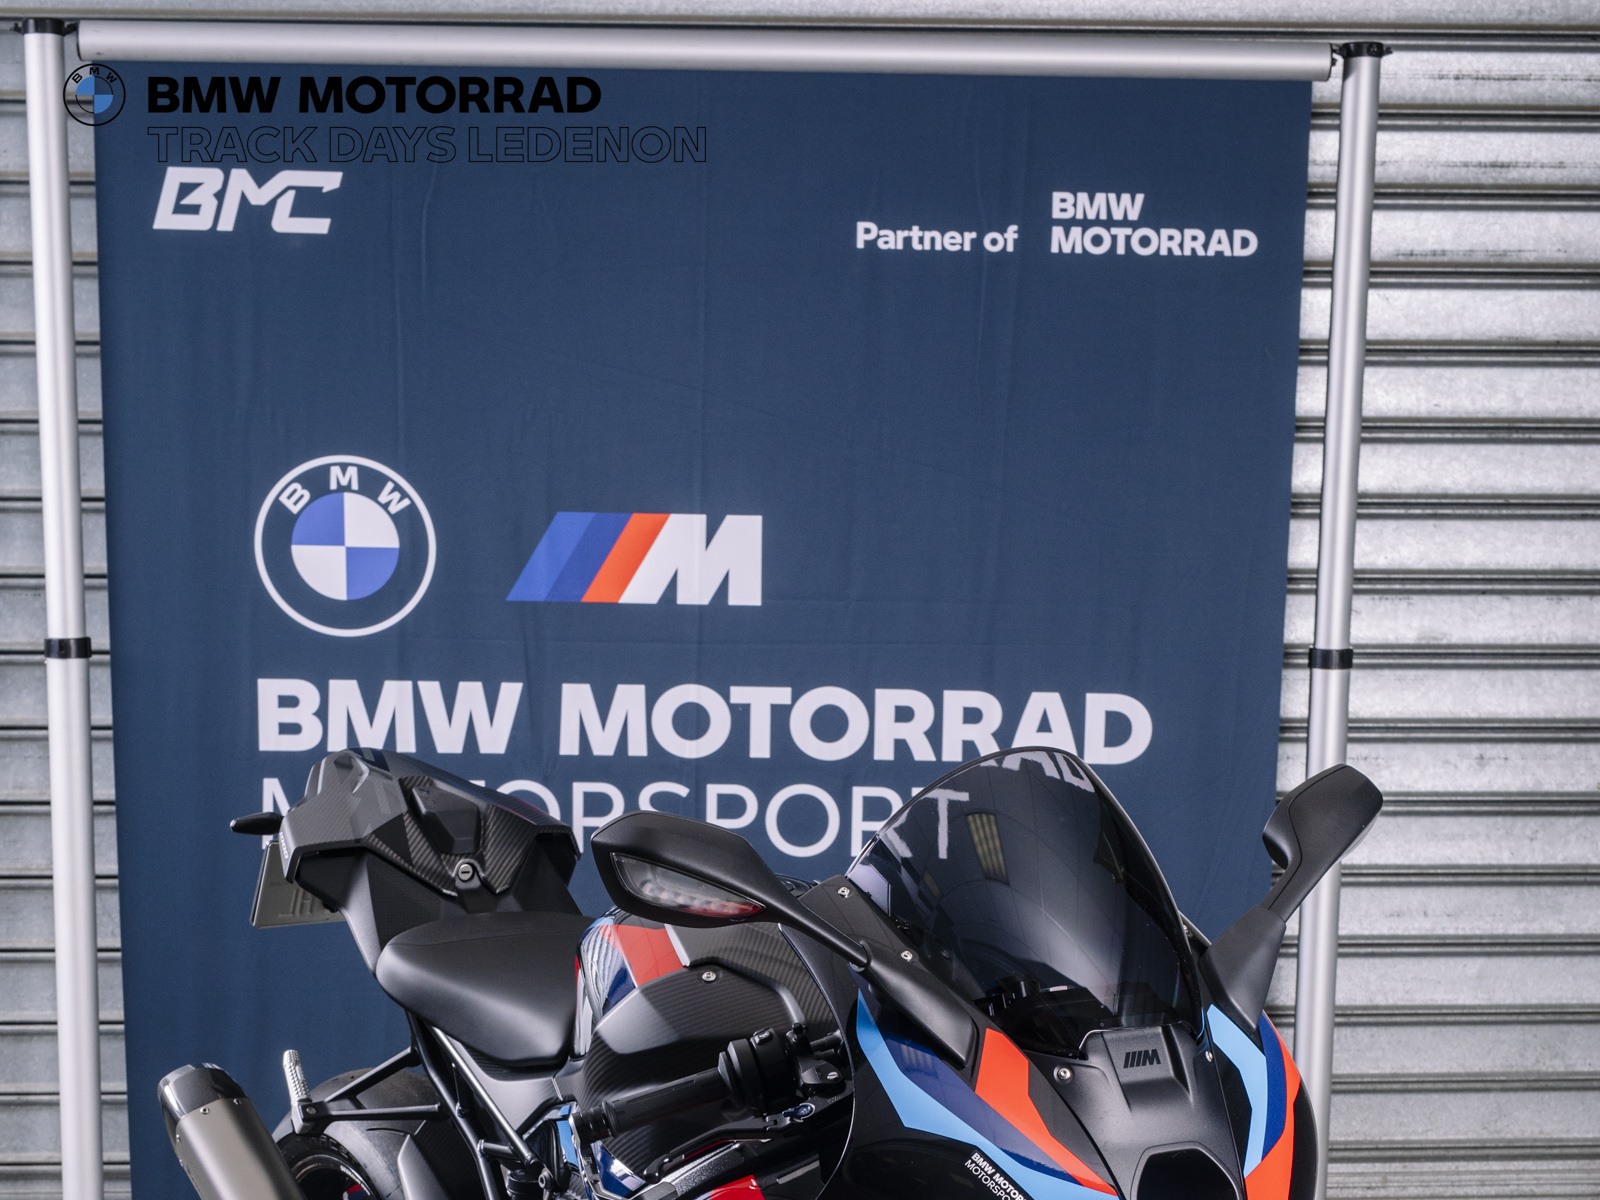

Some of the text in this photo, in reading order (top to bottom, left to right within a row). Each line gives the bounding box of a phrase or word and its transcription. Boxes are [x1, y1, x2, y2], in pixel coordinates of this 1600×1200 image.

[153, 166, 343, 234] BMC
[1051, 191, 1145, 221] BMW
[856, 221, 1019, 252] Partner of
[1051, 226, 1259, 257] MOTORRAD
[278, 465, 412, 515] BMW
[618, 513, 763, 606] M
[257, 678, 1153, 766] BMW MOTORRAD
[971, 1153, 996, 1175] BMW
